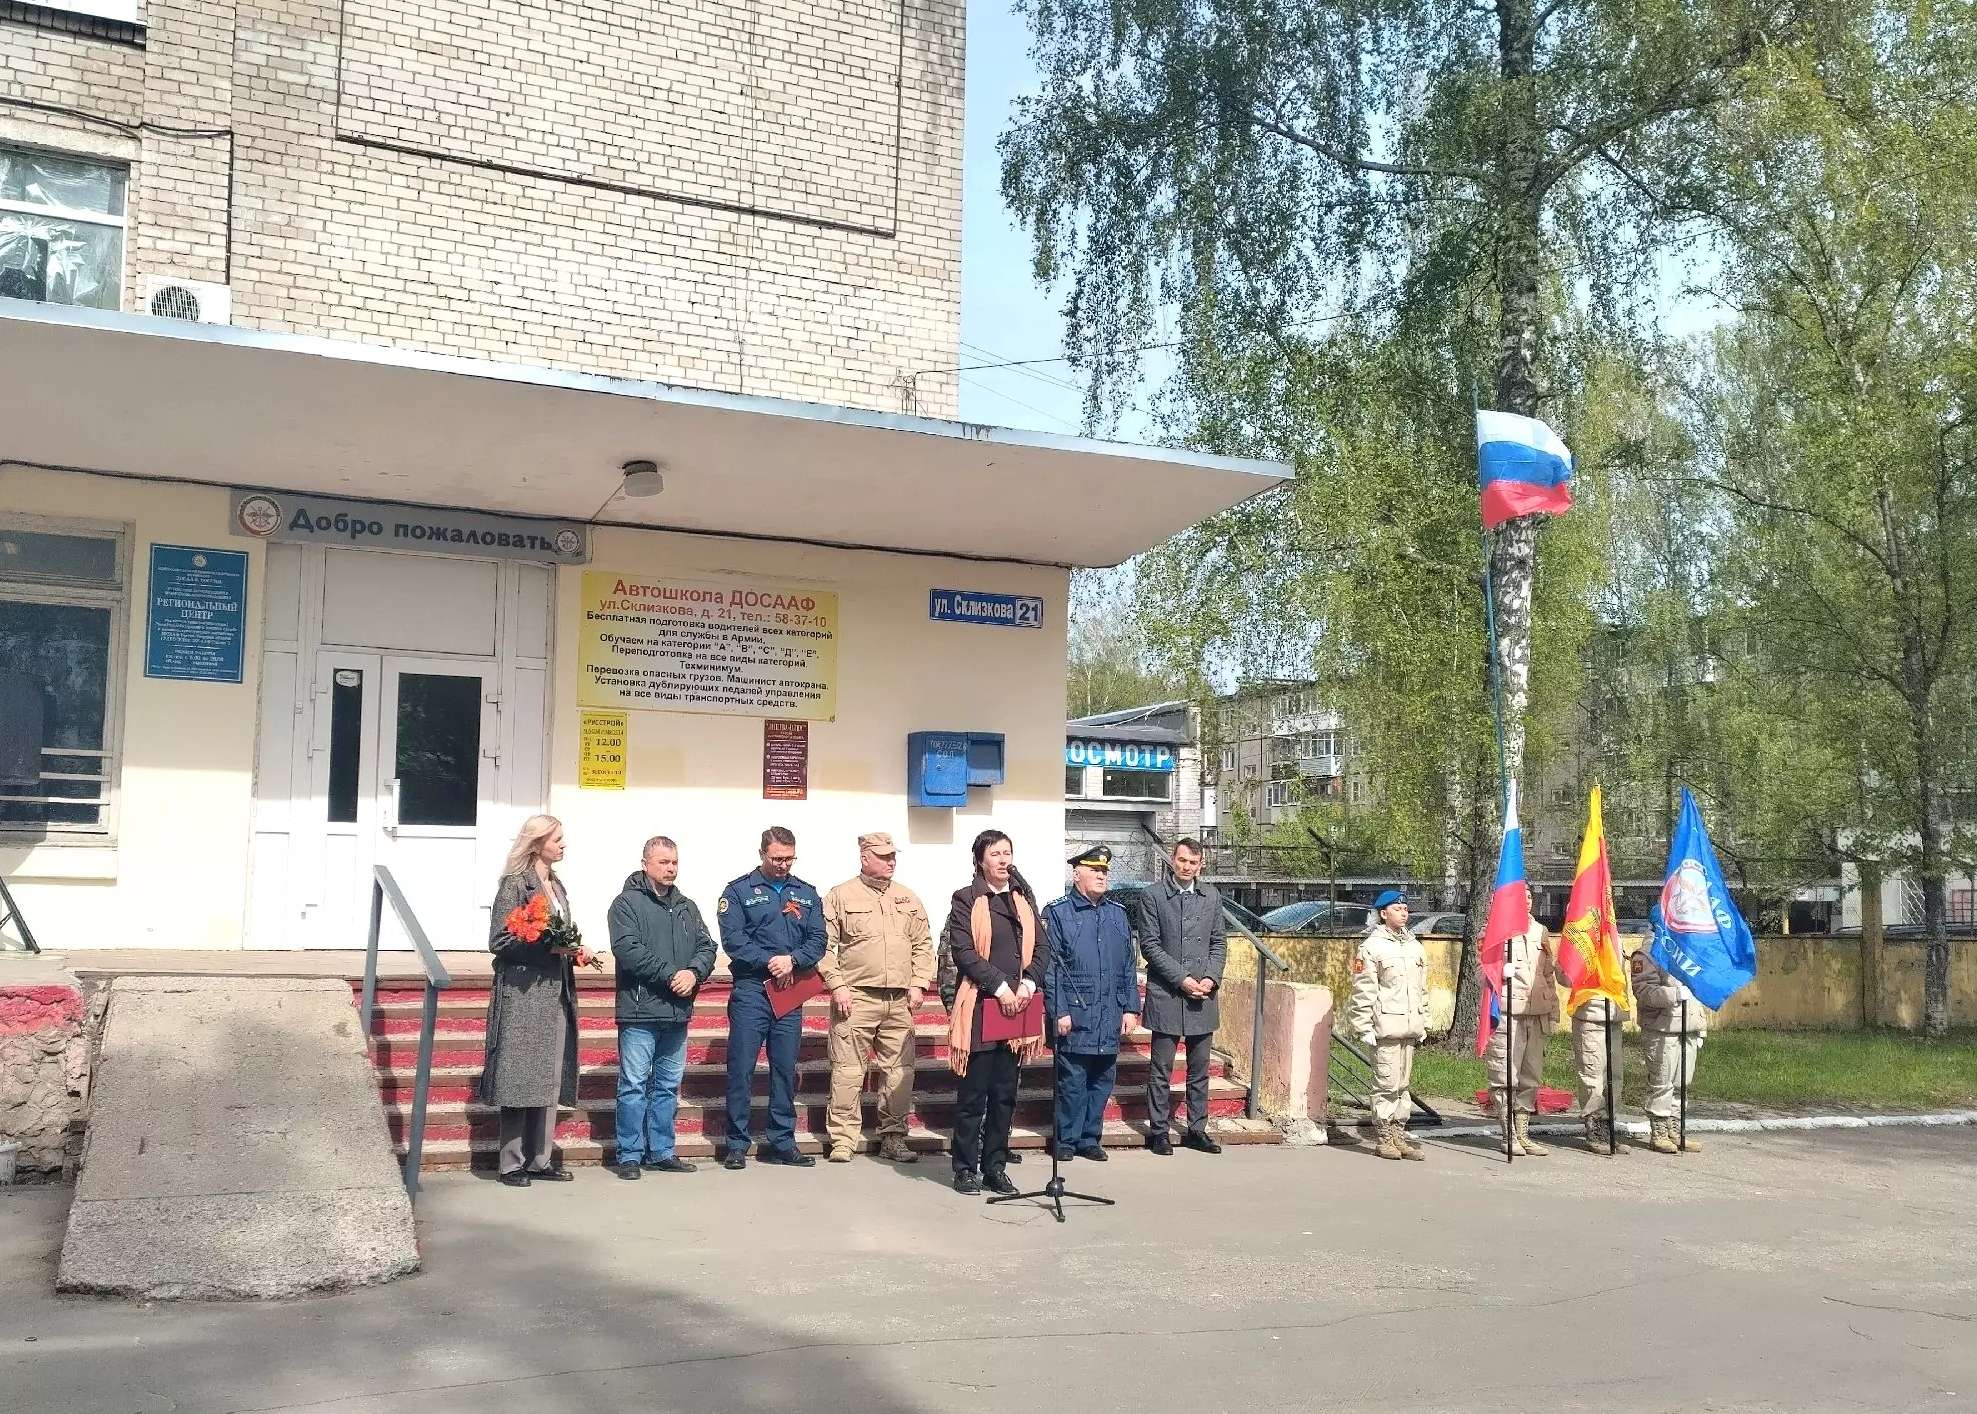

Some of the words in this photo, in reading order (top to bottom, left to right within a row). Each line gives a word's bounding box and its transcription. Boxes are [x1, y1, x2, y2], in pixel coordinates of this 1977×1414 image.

[288, 508, 384, 540] Добро
[157, 597, 237, 611] РЕГИОНАЛЬНЫЙ
[613, 579, 724, 605] Автошкола
[729, 589, 816, 612] ДОСААФ
[181, 609, 213, 620] ЦЕНТР
[701, 609, 714, 620] д.
[718, 608, 736, 622] 21,
[740, 611, 771, 623] тел.:
[775, 613, 827, 628] 58-37-10
[934, 598, 951, 617] ул.
[954, 594, 1014, 619] Склизкова
[1019, 602, 1041, 622] 21
[586, 611, 647, 625] Бесплатная
[649, 616, 706, 630] подготовка
[708, 622, 760, 634] водителей
[762, 627, 783, 636] всех
[786, 629, 833, 641] категорий
[600, 633, 644, 646] Обучаем
[646, 639, 659, 647] на
[661, 639, 712, 651] категории
[658, 629, 678, 638] для
[680, 629, 720, 641] службы
[731, 633, 766, 645] Армии.
[611, 644, 693, 658] Переподготовка
[695, 650, 707, 660] на
[710, 653, 727, 662] все
[729, 655, 756, 665] виды
[758, 657, 808, 669] категорий.
[679, 660, 743, 674] Техминимум.
[586, 664, 640, 676] Перевозка
[642, 669, 687, 680] опасных
[689, 672, 724, 683] грузов.
[726, 675, 776, 687] Машинист
[778, 679, 829, 691] автокрана.
[594, 675, 646, 687] Установка
[648, 680, 720, 693] дублирующих
[722, 685, 763, 696] педалей
[765, 688, 821, 701] управления
[619, 689, 631, 698] на
[634, 690, 652, 699] все
[654, 692, 682, 701] виды
[684, 693, 754, 705] транспортных
[756, 698, 798, 709] средств.
[596, 738, 622, 748] 12.00
[594, 754, 622, 763] 15.00
[1065, 740, 1171, 769] ОСМОТР
